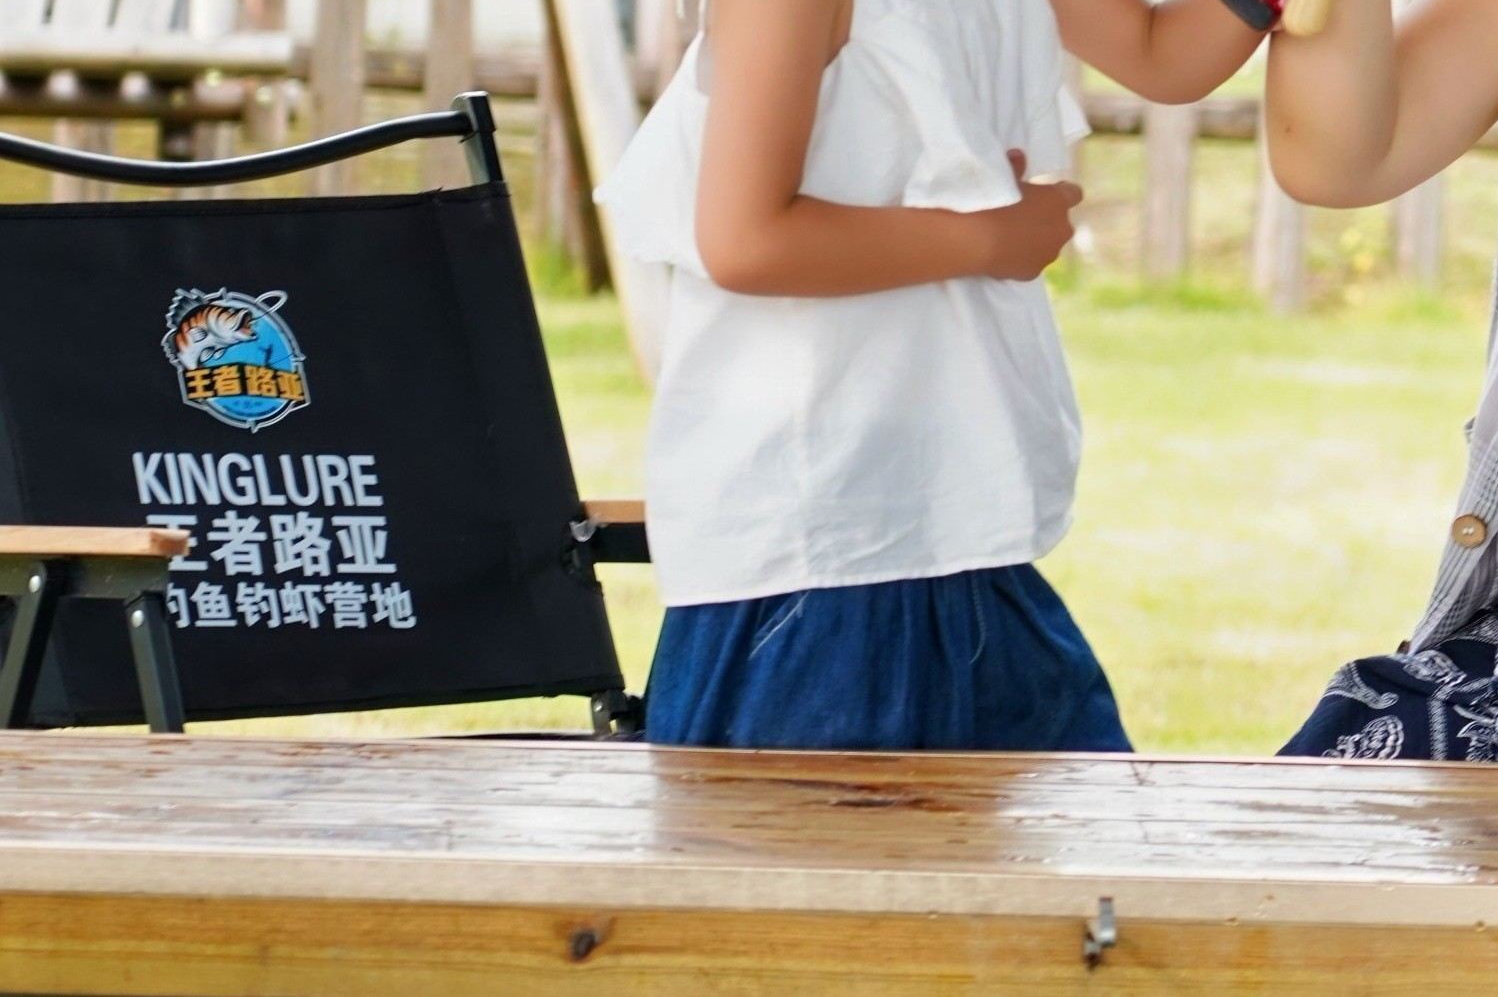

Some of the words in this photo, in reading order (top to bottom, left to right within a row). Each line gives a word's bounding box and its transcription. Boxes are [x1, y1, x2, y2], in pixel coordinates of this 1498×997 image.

[185, 364, 305, 401] 王者路亚
[132, 452, 384, 507] KINGLURE
